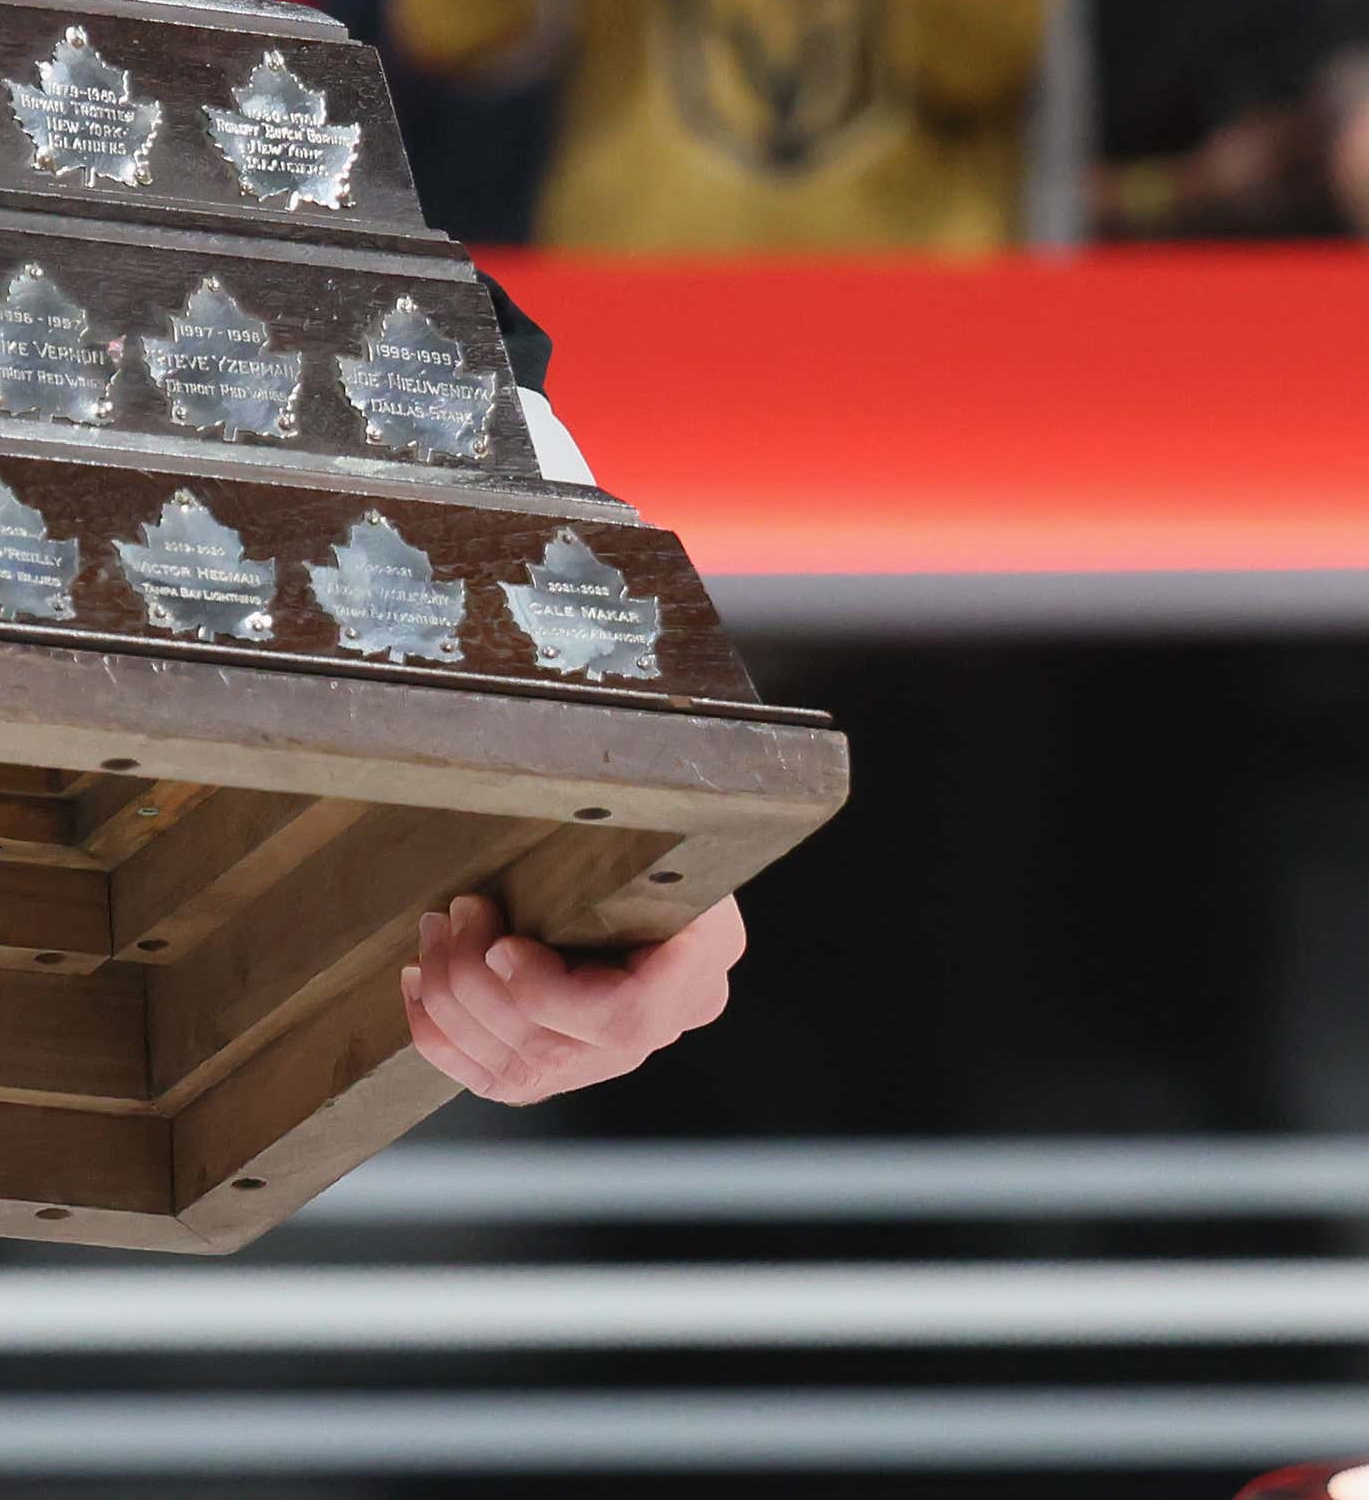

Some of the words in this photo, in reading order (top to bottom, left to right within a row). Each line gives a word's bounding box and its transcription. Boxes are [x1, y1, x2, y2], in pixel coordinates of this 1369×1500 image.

[48, 133, 127, 155] ISLANDERS
[33, 340, 105, 365] VERNON
[376, 343, 452, 366] 1998-1999
[212, 355, 295, 380] YZERMAN
[166, 379, 216, 396] DETROIT
[371, 398, 425, 419] DALLAS
[197, 567, 261, 586] HEDMAN
[528, 602, 575, 618] CALE
[580, 605, 640, 623] MAKAR
